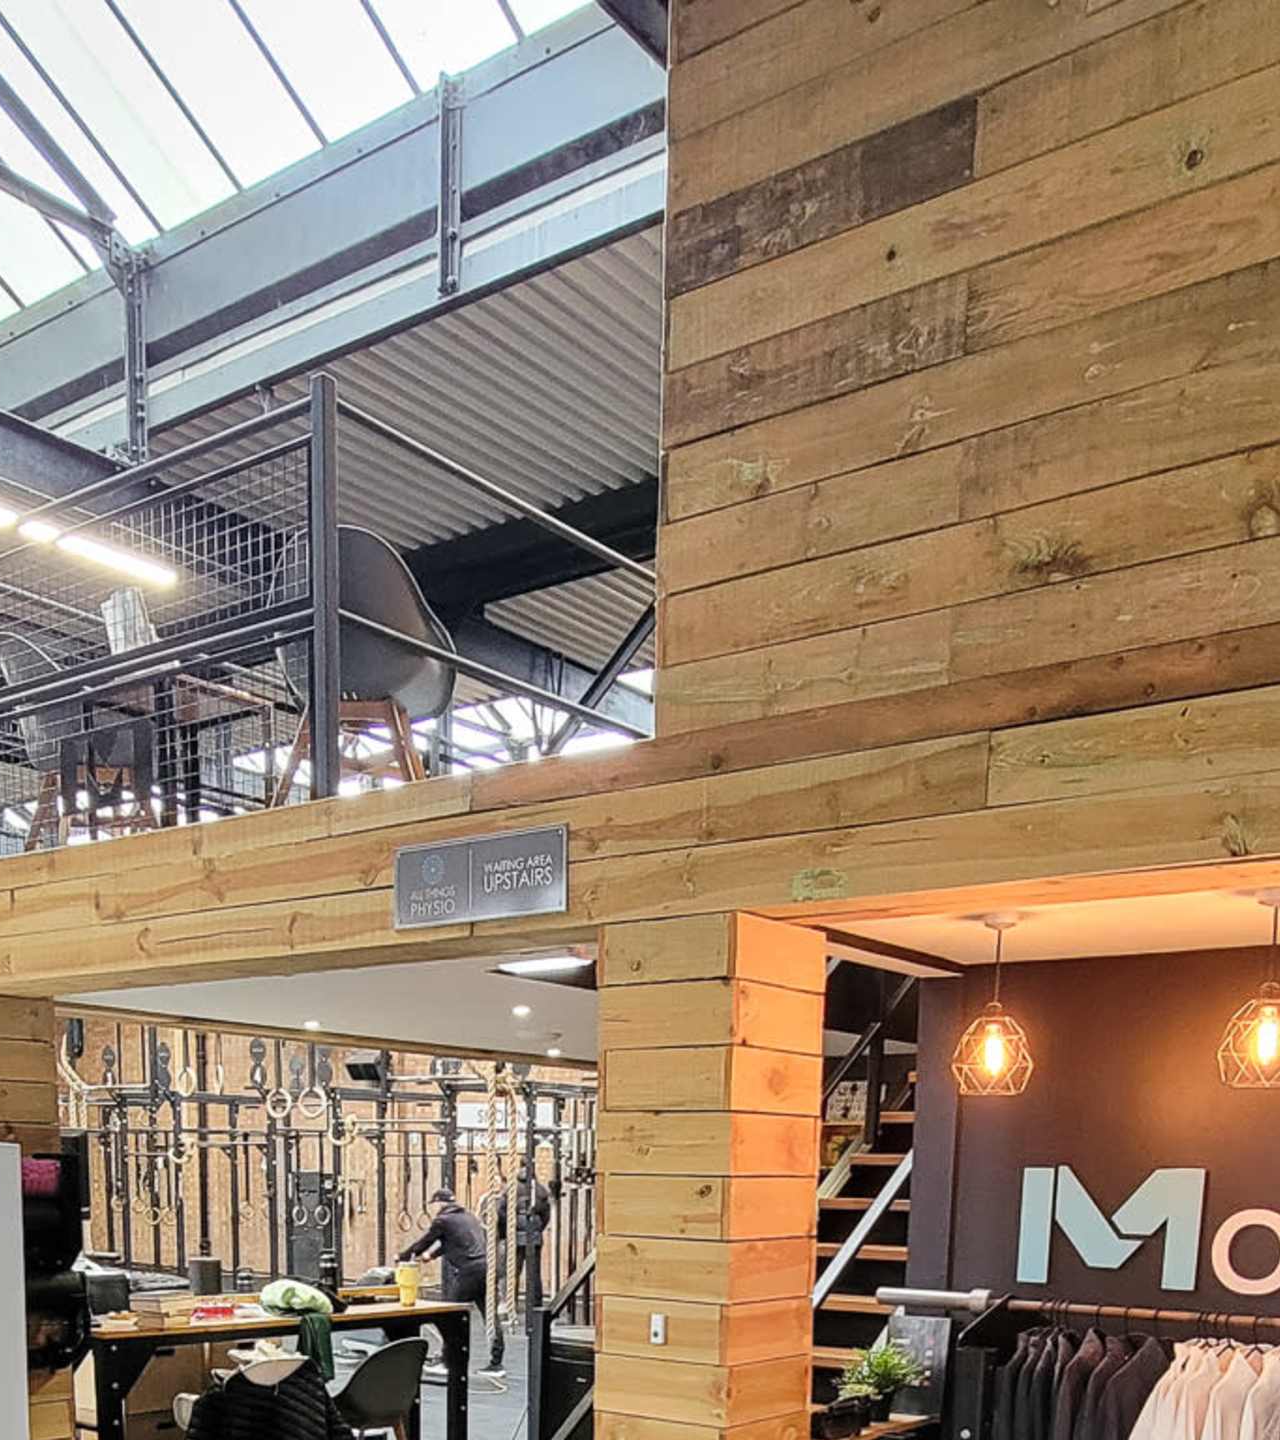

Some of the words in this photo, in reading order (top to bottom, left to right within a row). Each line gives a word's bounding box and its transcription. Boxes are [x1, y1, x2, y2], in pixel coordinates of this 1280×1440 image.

[484, 856, 524, 873] WAITING
[526, 853, 553, 869] AREA
[483, 866, 553, 893] UPSTAIRS
[410, 898, 456, 918] PHYSIO
